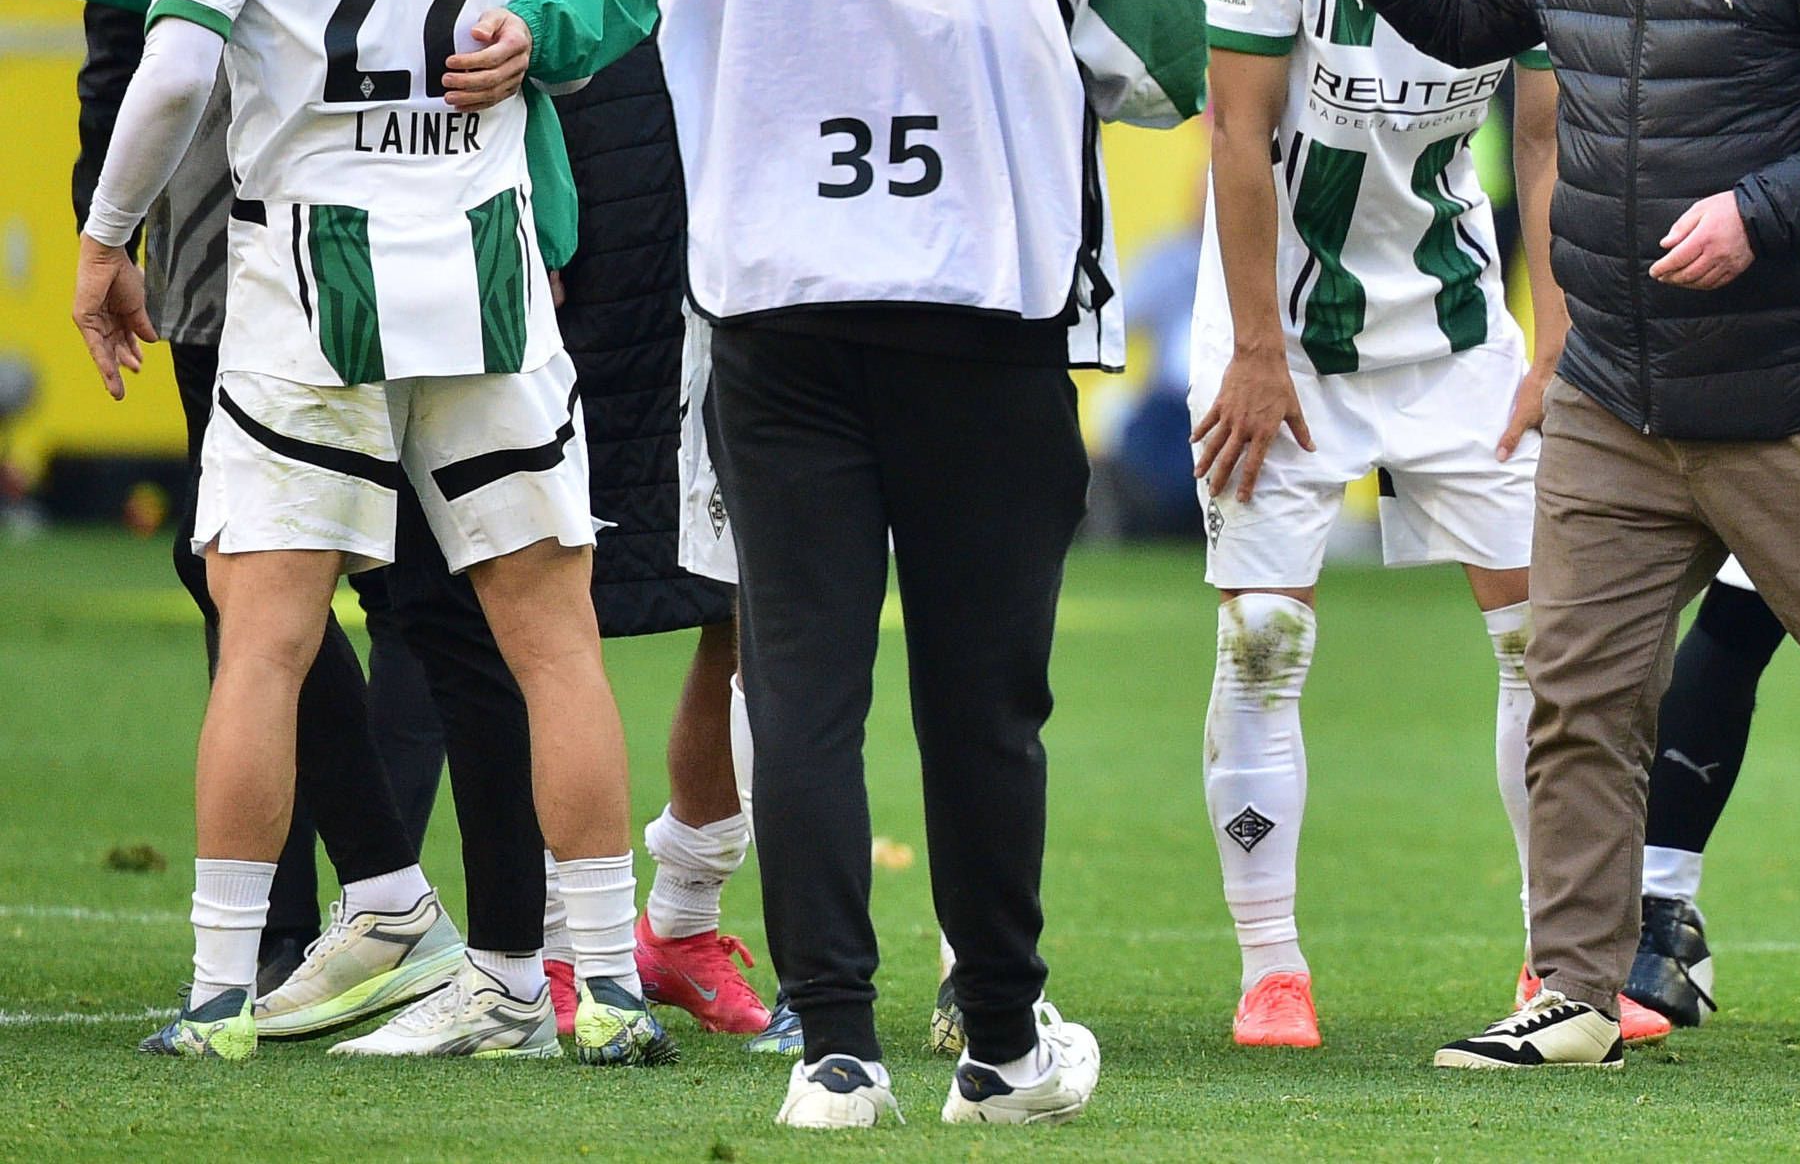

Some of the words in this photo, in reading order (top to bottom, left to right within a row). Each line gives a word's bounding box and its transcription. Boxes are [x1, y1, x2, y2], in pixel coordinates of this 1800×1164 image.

[1312, 62, 1505, 106] REUTER
[354, 110, 482, 156] LAINER
[818, 115, 943, 198] 35
